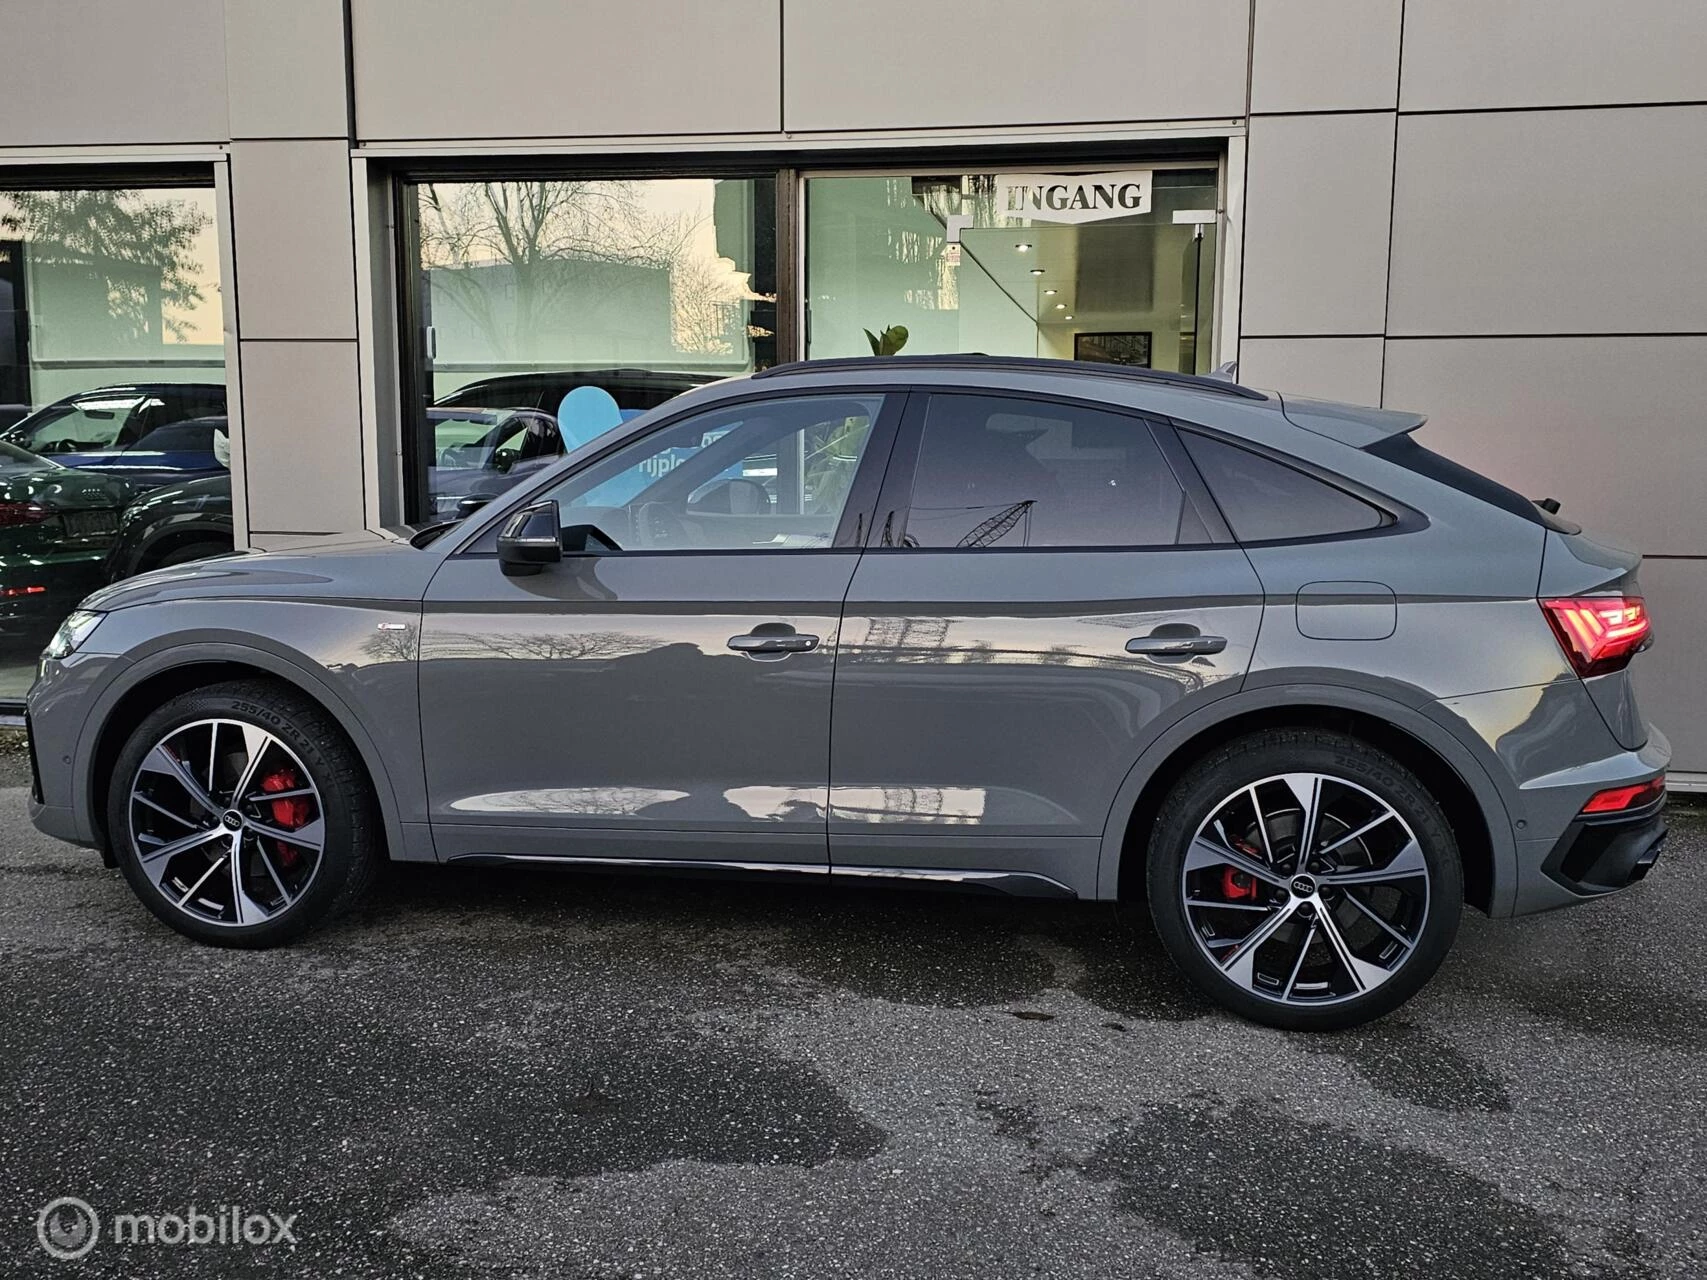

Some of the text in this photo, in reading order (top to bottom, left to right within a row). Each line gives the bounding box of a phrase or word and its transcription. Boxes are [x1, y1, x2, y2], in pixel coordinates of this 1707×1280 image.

[1006, 183, 1143, 211] INGANG
[231, 700, 281, 725] 255/40
[281, 722, 301, 740] ZR
[1334, 755, 1394, 787] 255/40
